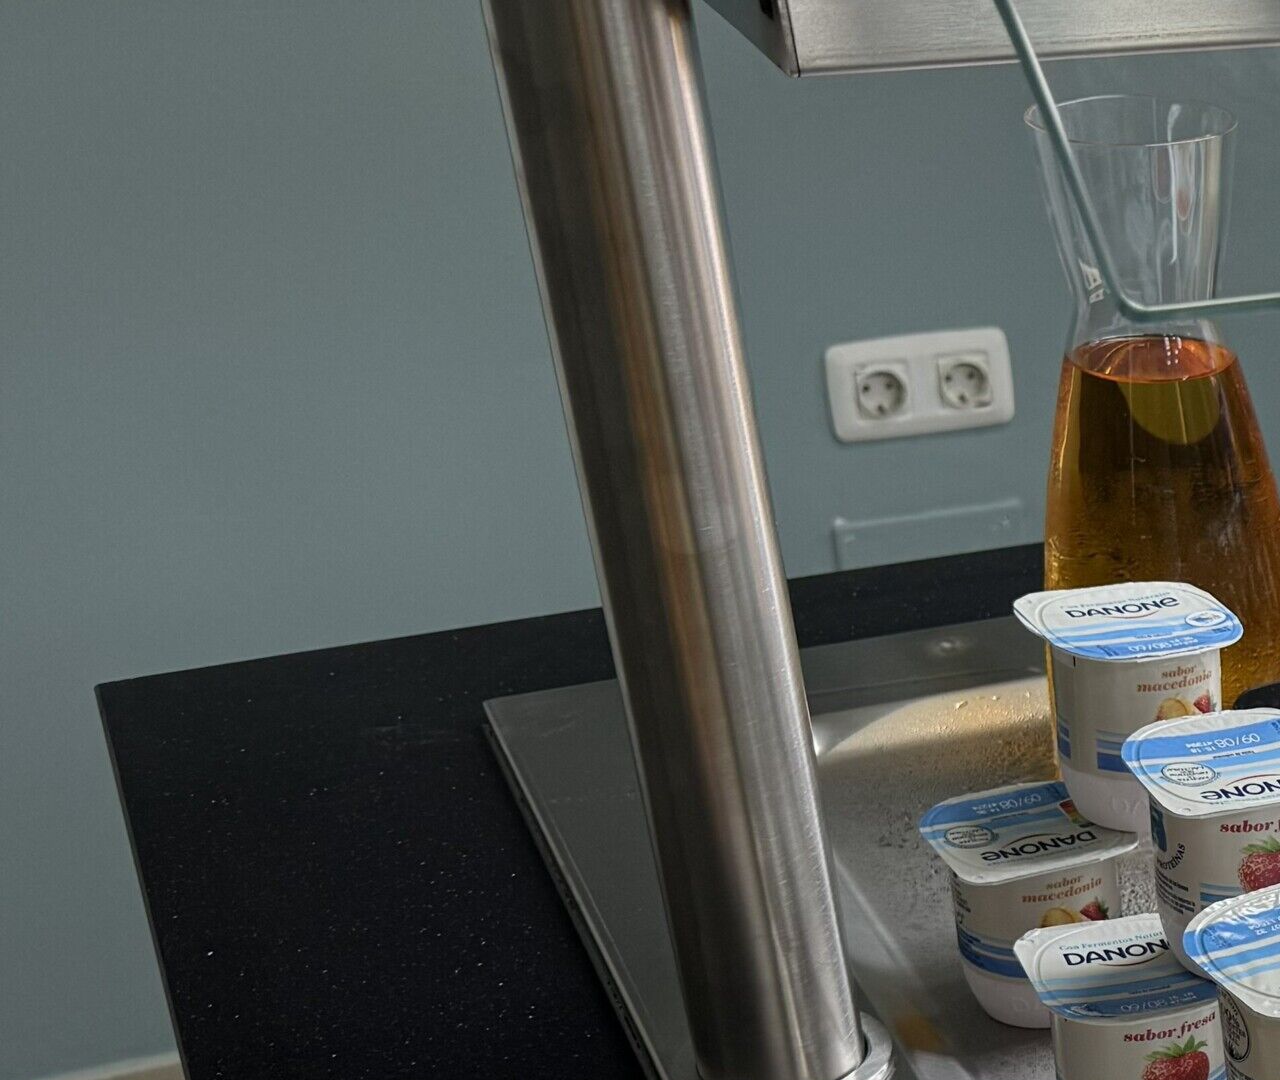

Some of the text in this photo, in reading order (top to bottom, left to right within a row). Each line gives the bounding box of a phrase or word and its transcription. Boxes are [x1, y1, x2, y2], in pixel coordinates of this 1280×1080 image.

[1065, 596, 1181, 619] DANONE
[1136, 668, 1213, 693] macedonia
[1161, 664, 1198, 679] sabor
[1214, 732, 1261, 749] 09/08
[1219, 819, 1274, 833] sabor
[981, 830, 1098, 862] DANONE
[1021, 877, 1103, 904] macedonia
[1046, 874, 1084, 890] sabor
[1063, 938, 1170, 966] DANON
[1123, 1010, 1217, 1044] sabor fresa
